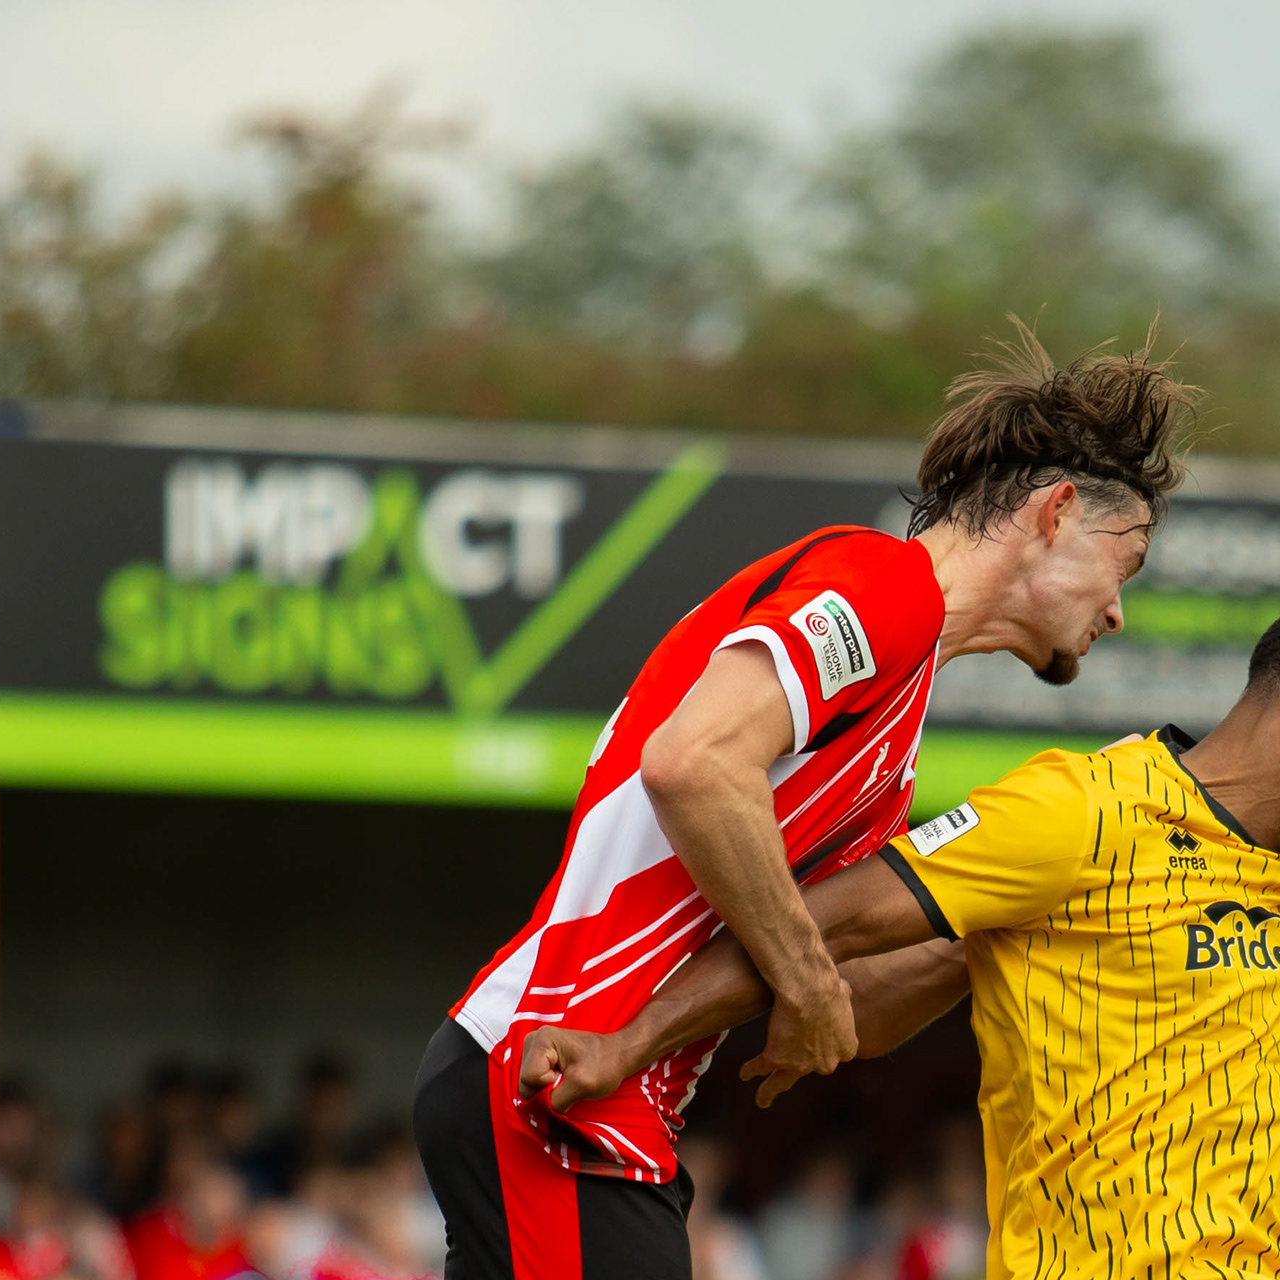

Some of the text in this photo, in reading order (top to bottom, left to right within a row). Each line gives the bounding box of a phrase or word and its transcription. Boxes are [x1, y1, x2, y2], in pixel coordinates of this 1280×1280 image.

[163, 456, 584, 596] IMPACT
[100, 560, 438, 700] SIGNS
[823, 642, 837, 682] LEAGUE
[827, 634, 844, 682] NATIONAL
